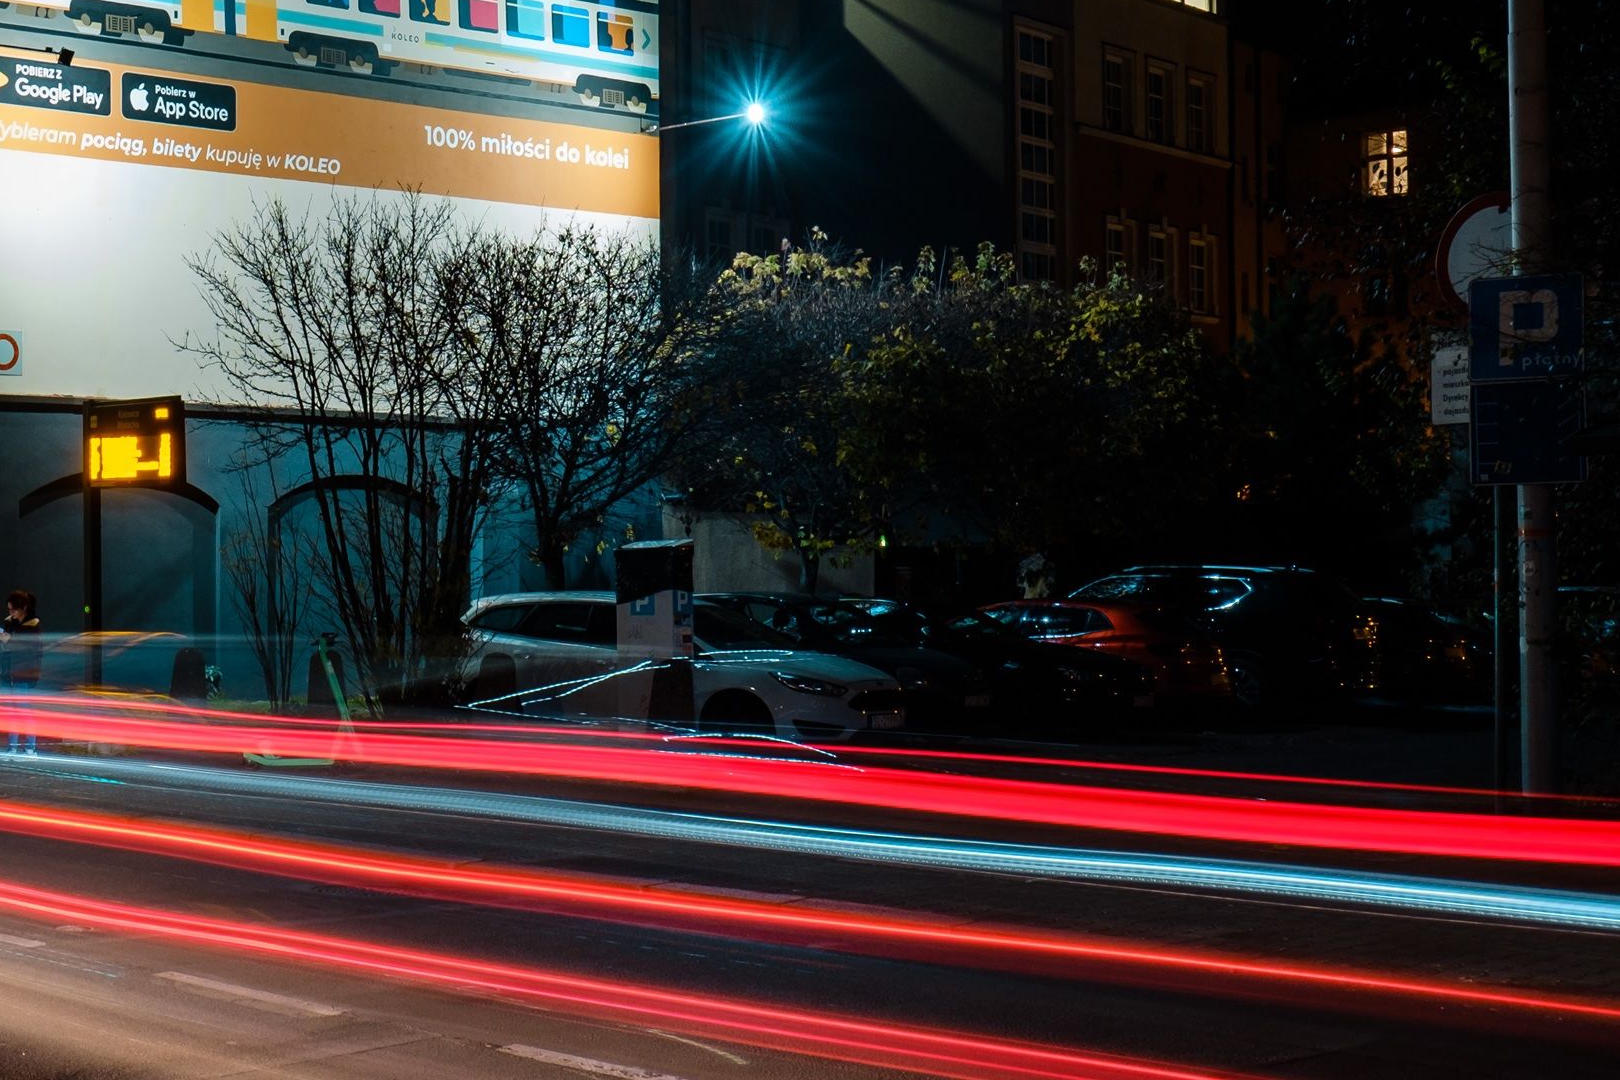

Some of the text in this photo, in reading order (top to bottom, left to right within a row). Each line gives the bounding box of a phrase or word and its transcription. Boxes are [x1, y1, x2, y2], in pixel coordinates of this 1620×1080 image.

[391, 32, 420, 43] KOLEO
[15, 64, 55, 79] POBIERZ
[15, 77, 104, 110] Google Play
[155, 84, 196, 99] Pobierz w
[154, 96, 229, 122] App Store
[81, 132, 147, 156] pociąg,
[152, 137, 202, 163] bilety
[206, 144, 262, 170] kupuję
[266, 154, 281, 168] w
[284, 154, 341, 175] KOLEO
[424, 124, 629, 169] 100% miłości do kolei
[1498, 289, 1560, 367] P
